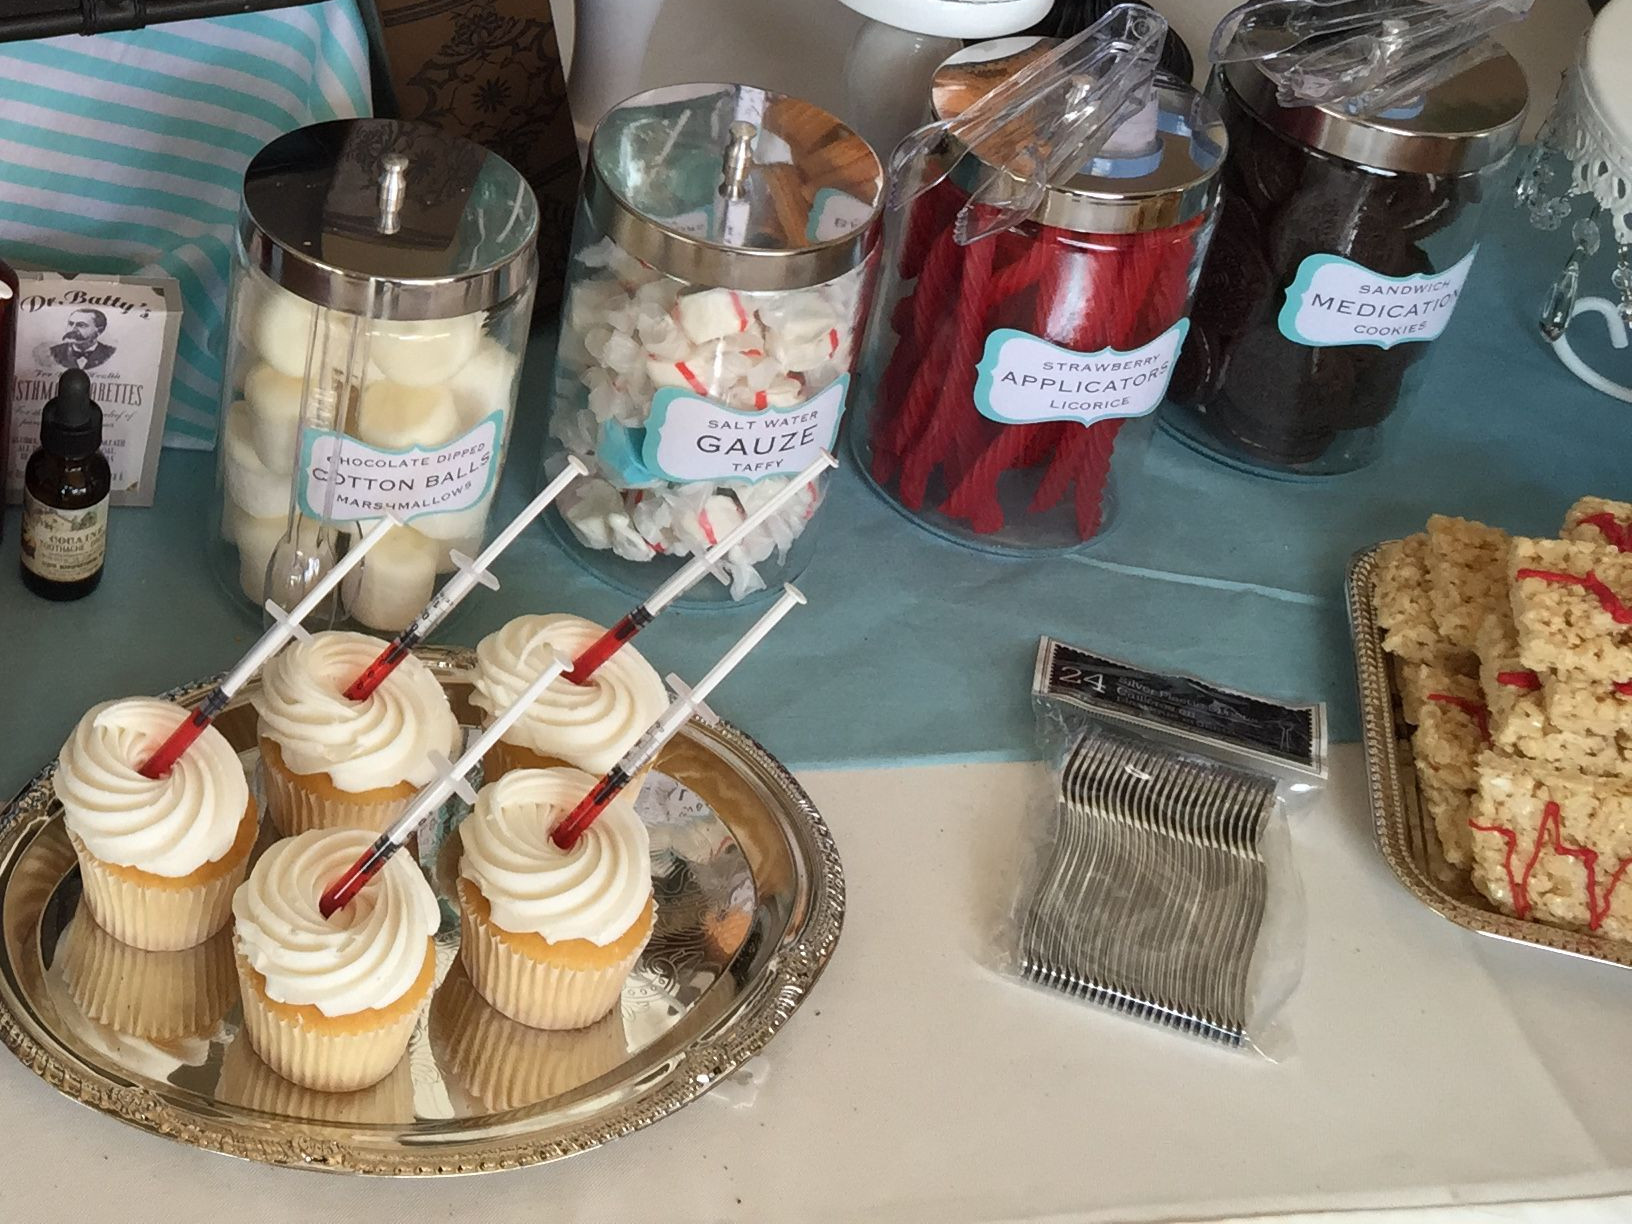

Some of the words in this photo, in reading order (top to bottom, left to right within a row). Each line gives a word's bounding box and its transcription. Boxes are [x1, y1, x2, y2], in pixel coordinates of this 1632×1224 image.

[1358, 279, 1451, 295] SANDWICH
[1353, 320, 1427, 336] COOKIES
[1043, 353, 1161, 372] STRAWBERRY
[1001, 360, 1169, 393] APPLICATORS
[1050, 396, 1131, 411] LICORICE
[708, 419, 757, 430] SALT
[764, 410, 818, 429] WATER
[696, 424, 818, 456] GAUZE
[436, 442, 485, 464] DIPPED
[425, 452, 490, 489] BALLS
[731, 458, 784, 472] TAFFY
[1058, 665, 1107, 696] 24
